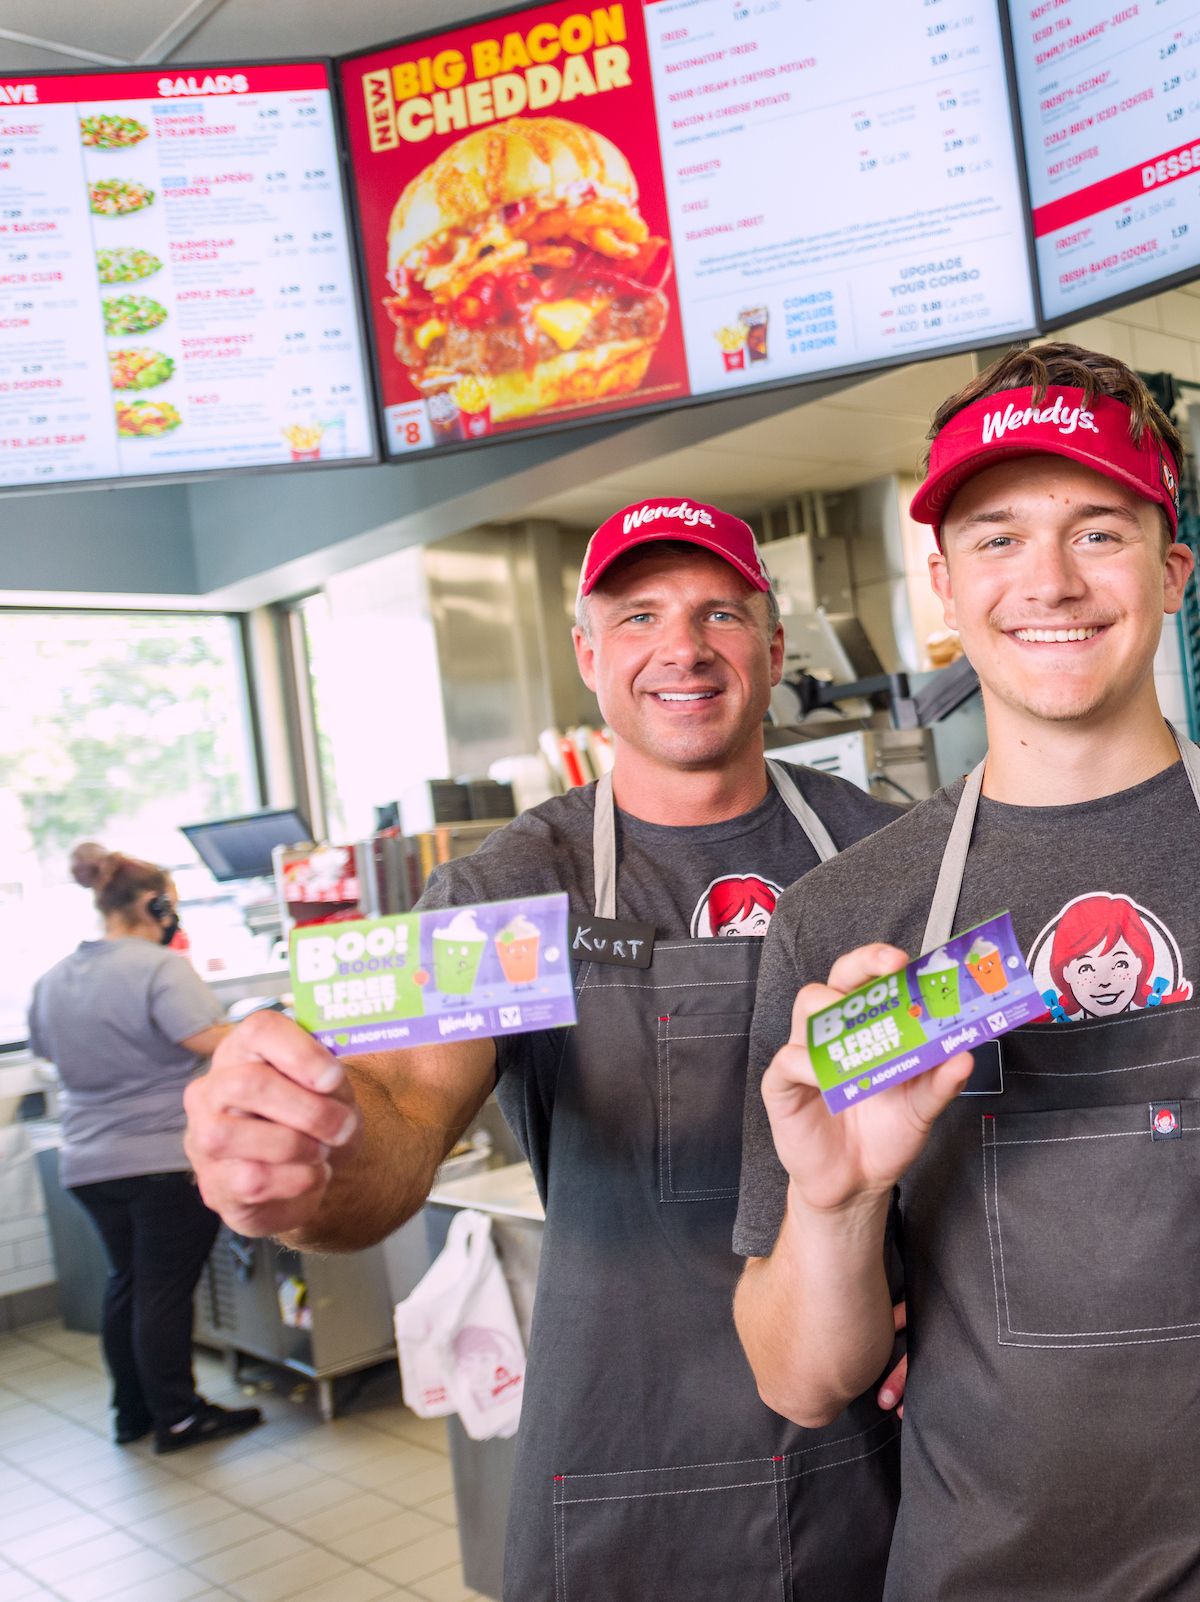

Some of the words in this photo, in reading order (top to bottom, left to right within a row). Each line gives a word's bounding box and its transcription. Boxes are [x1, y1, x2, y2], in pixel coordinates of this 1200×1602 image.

[661, 28, 688, 43] FRIES
[1032, 25, 1054, 43] ICED
[1055, 15, 1071, 31] TEA
[1034, 42, 1066, 66] SIMPLY
[1067, 24, 1105, 49] ORANGE
[1110, 4, 1140, 27] JUICE
[391, 50, 467, 101] BIG
[471, 4, 627, 80] BACON
[664, 50, 723, 74] BACONATOR
[730, 41, 758, 57] FRIES
[157, 75, 249, 97] SALADS
[668, 88, 693, 103] SOUR
[695, 80, 729, 96] CREAM
[740, 67, 776, 85] CHIVES
[778, 57, 817, 75] POTATO
[396, 45, 632, 143] CHEDDAR
[154, 115, 205, 126] SUMMER
[370, 77, 393, 144] NEW
[672, 113, 705, 130] BACON
[714, 101, 751, 119] CHEESE
[753, 91, 791, 109] POTATO
[1043, 129, 1067, 147] COLD
[1069, 115, 1095, 136] BREW
[1096, 104, 1118, 124] ICED
[1119, 88, 1154, 112] COFFEE
[155, 125, 236, 139] STRAWBERRY
[677, 159, 721, 178] NUGGETS
[1047, 160, 1065, 177] HOT
[1065, 145, 1099, 168] COFFEE
[193, 171, 254, 185] JALAPEÑO
[163, 187, 210, 197] POPPER
[681, 199, 709, 214] CHILI
[12, 222, 56, 233] BACON
[685, 222, 734, 242] SEASONAL
[736, 214, 764, 230] FRUIT
[169, 239, 235, 251] PARMESAN
[1055, 229, 1088, 251] FROSTY
[171, 251, 218, 263] CAESAR
[1058, 254, 1119, 286] FRESH-BAKED
[1120, 239, 1158, 262] COOKIE
[31, 272, 62, 282] CLUB
[899, 256, 963, 281] UPGRADE
[176, 290, 212, 301] APPLE
[214, 287, 255, 298] PECAN
[889, 280, 927, 298] YOUR
[928, 268, 981, 290] COMBO
[783, 290, 833, 311] COMBOS
[785, 305, 834, 325] INCLUDE
[180, 334, 254, 347] SOUTHWEST
[786, 326, 802, 340] SM
[803, 320, 837, 337] FRIES
[183, 347, 242, 360] AVOCADO
[801, 337, 836, 353] DRINK
[13, 378, 62, 391] POPPER
[187, 394, 219, 405] TACO
[982, 395, 1099, 444] Wendy's
[12, 437, 50, 448] BLACK
[54, 433, 85, 444] BEAN
[623, 503, 715, 535] Wendy's
[297, 924, 409, 983] BOO!
[572, 925, 643, 961] KURT
[338, 954, 406, 976] BOOKS
[332, 974, 397, 1004] FREE
[323, 997, 396, 1020] FROSTY
[813, 976, 898, 1048] BOO!
[846, 996, 900, 1030] BOOKS
[350, 1026, 410, 1044] ADOPTION
[827, 1040, 845, 1062] 5
[843, 1016, 899, 1054] FREE
[840, 1033, 901, 1071] FROSTY
[871, 1055, 920, 1085] ADOPTION
